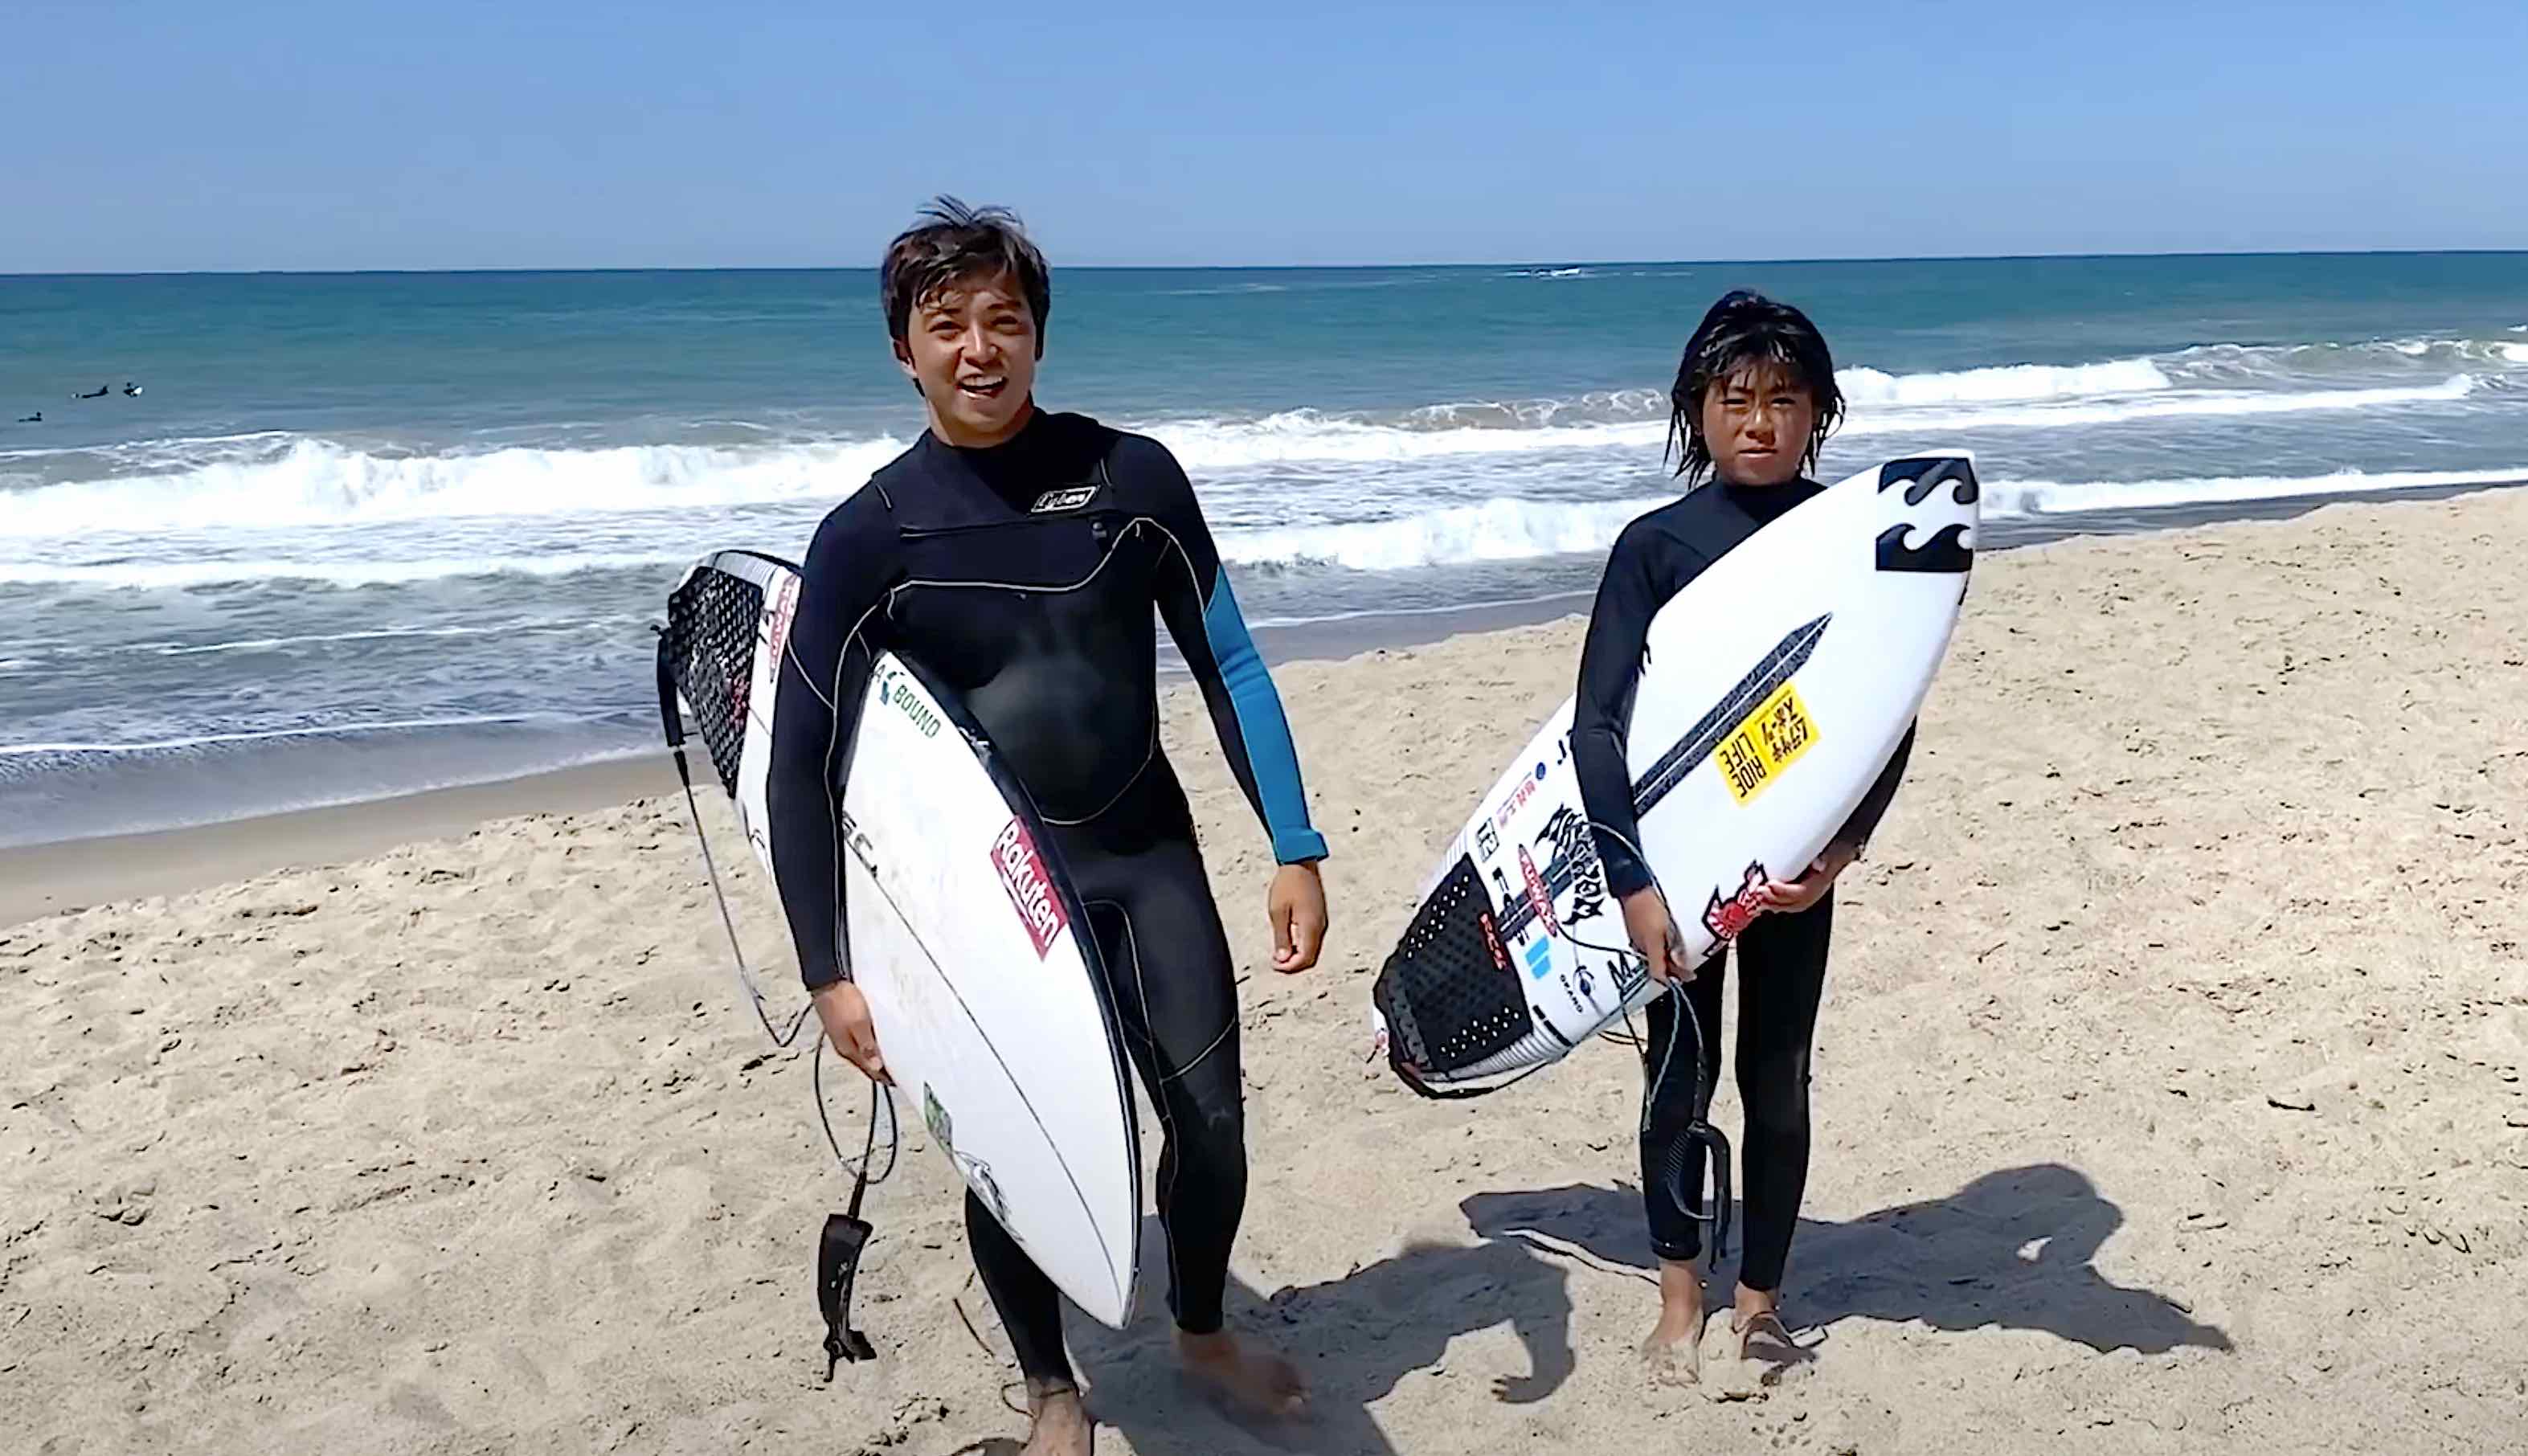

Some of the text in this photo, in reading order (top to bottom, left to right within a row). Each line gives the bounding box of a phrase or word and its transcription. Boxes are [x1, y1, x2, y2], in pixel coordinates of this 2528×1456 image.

[892, 683, 942, 738] BOUND
[1719, 732, 1755, 775] LIFE
[1731, 755, 1767, 798] RIDE
[996, 820, 1060, 947] Rakuten
